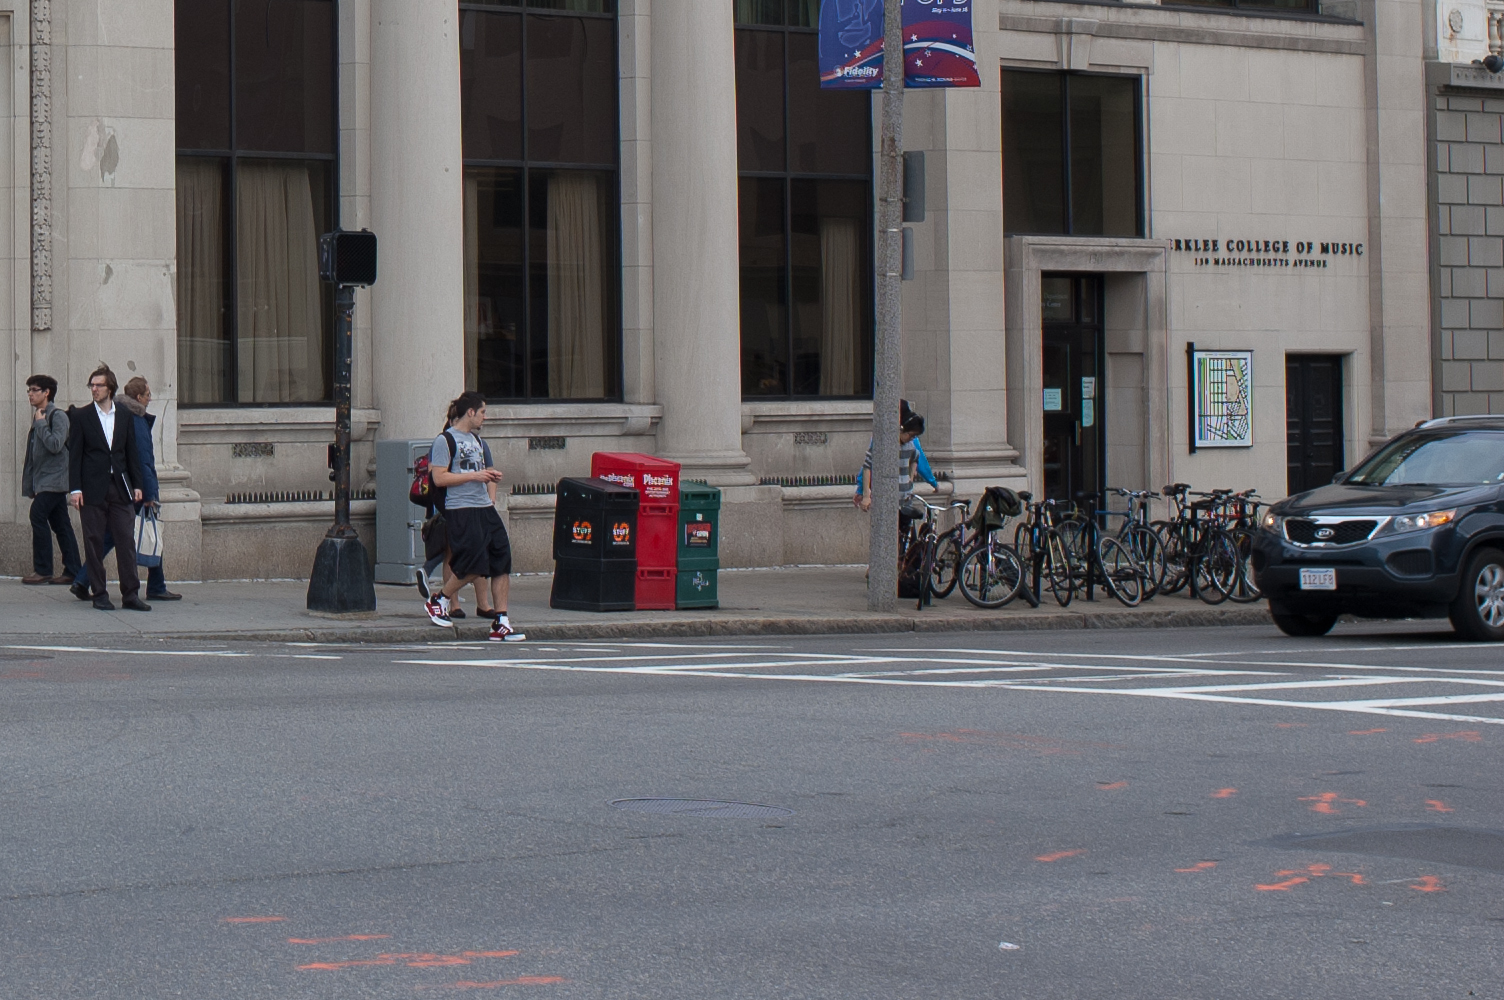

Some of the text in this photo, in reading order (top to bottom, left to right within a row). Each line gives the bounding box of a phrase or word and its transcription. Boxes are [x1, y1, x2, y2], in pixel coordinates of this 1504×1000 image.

[844, 66, 879, 78] Fidelity
[1225, 239, 1290, 254] COLLEGE
[1296, 241, 1313, 255] OF
[1320, 242, 1364, 256] MUSIC
[1213, 257, 1290, 268] MASSACHUSETTS
[1293, 259, 1328, 269] AVENUE
